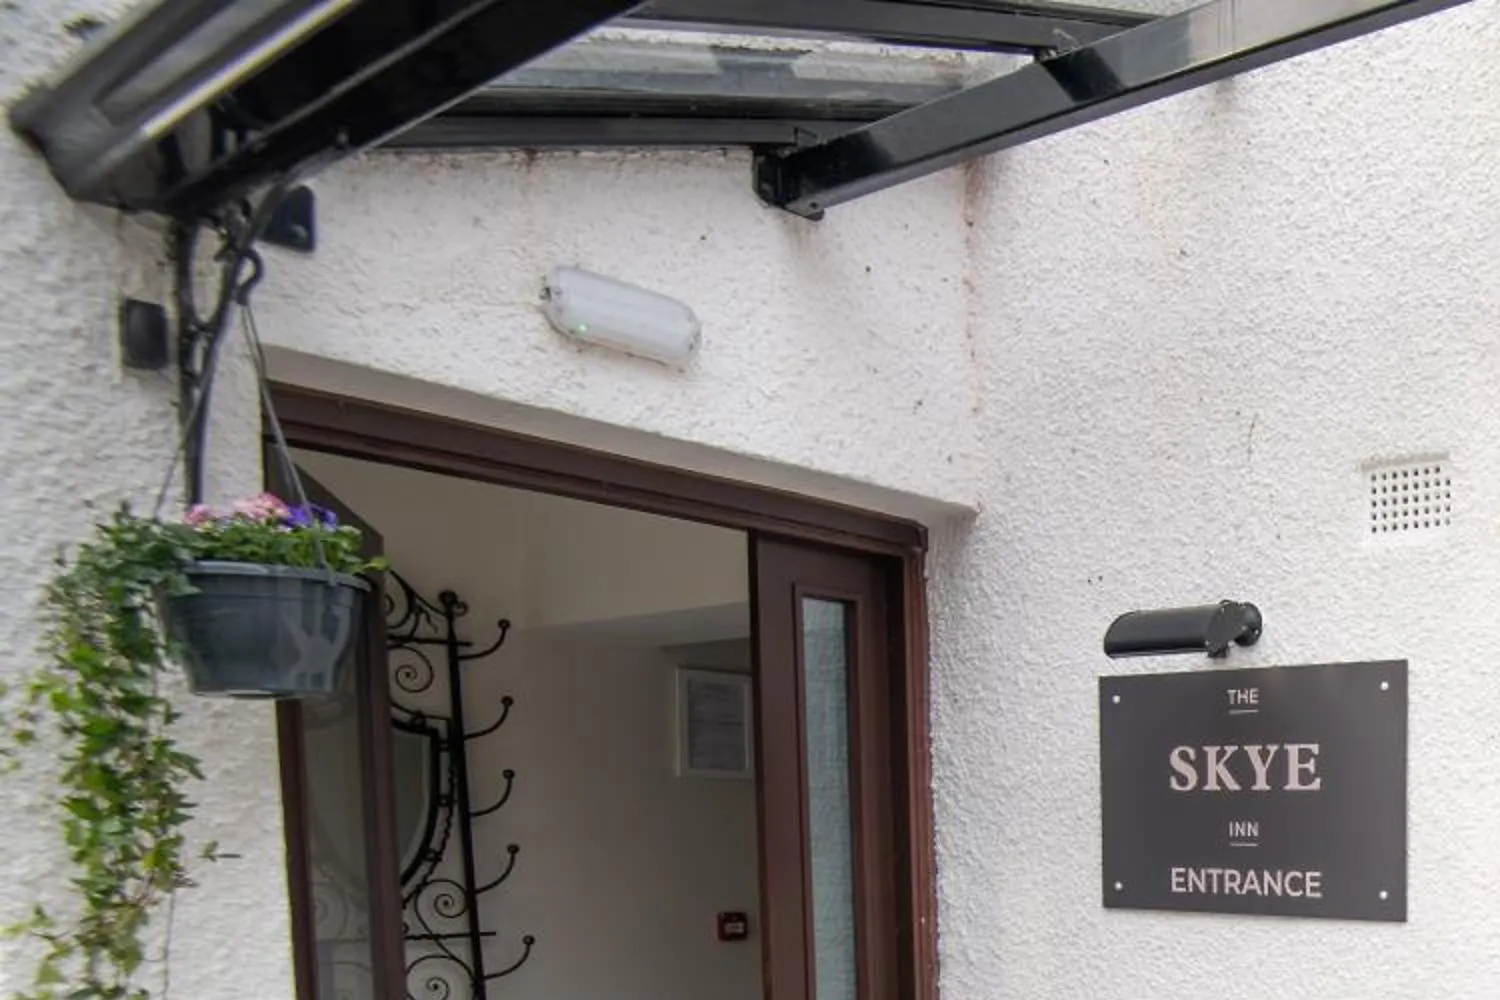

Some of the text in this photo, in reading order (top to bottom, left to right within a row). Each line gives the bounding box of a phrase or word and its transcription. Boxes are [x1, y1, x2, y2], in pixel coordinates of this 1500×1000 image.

[1226, 687, 1260, 705] THE
[1168, 742, 1322, 792] SKYE
[1228, 820, 1260, 838] INN
[1170, 866, 1324, 899] ENTRANCE
